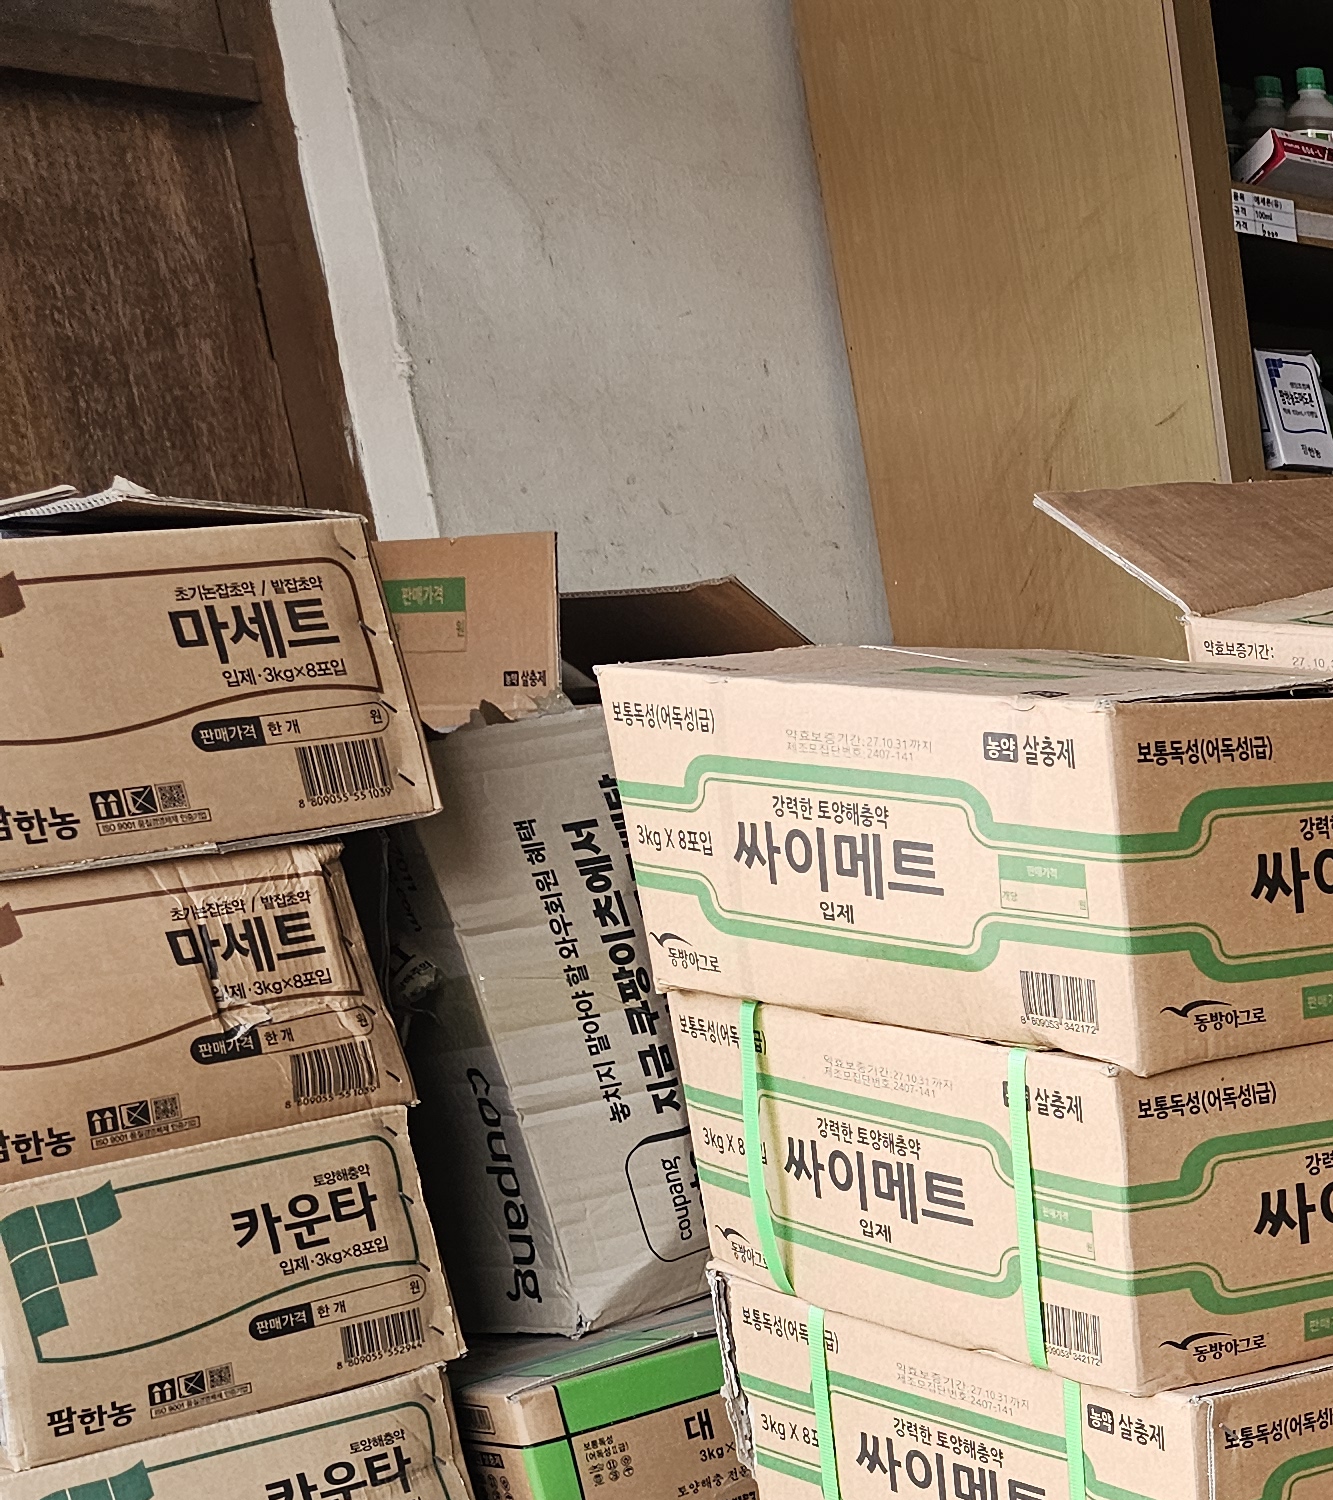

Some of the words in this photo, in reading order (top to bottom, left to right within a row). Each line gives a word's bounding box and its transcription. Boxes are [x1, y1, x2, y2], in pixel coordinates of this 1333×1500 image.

[271, 574, 324, 596] 밭잡초약
[168, 599, 341, 665] 마세트
[199, 722, 258, 746] 판매가격
[267, 719, 282, 738] 한
[285, 718, 301, 738] 개
[1023, 736, 1075, 769] 살충제
[513, 817, 545, 865] 혜택
[636, 824, 663, 852] 3kg
[678, 829, 713, 856] 8포입
[772, 795, 813, 821] 강력한
[817, 801, 889, 828] 토양해충약
[733, 819, 945, 900] 싸이메트
[164, 910, 328, 973] 마세트
[537, 871, 578, 958] 와우회원
[561, 817, 663, 1035] 쿠팡이츠에서
[820, 901, 855, 925] 입제
[563, 957, 588, 988] 할
[668, 947, 722, 974] 동방아그로
[569, 987, 610, 1055] 말아야
[599, 1060, 632, 1124] 놓치지
[637, 1043, 682, 1116] 지금
[313, 1163, 372, 1187] 토양해충약
[465, 1067, 543, 1304] coupang
[660, 1156, 693, 1241] coupang
[783, 1136, 974, 1227] 싸이메트
[230, 1180, 378, 1256] 카운타
[47, 1401, 137, 1438] 팜한농
